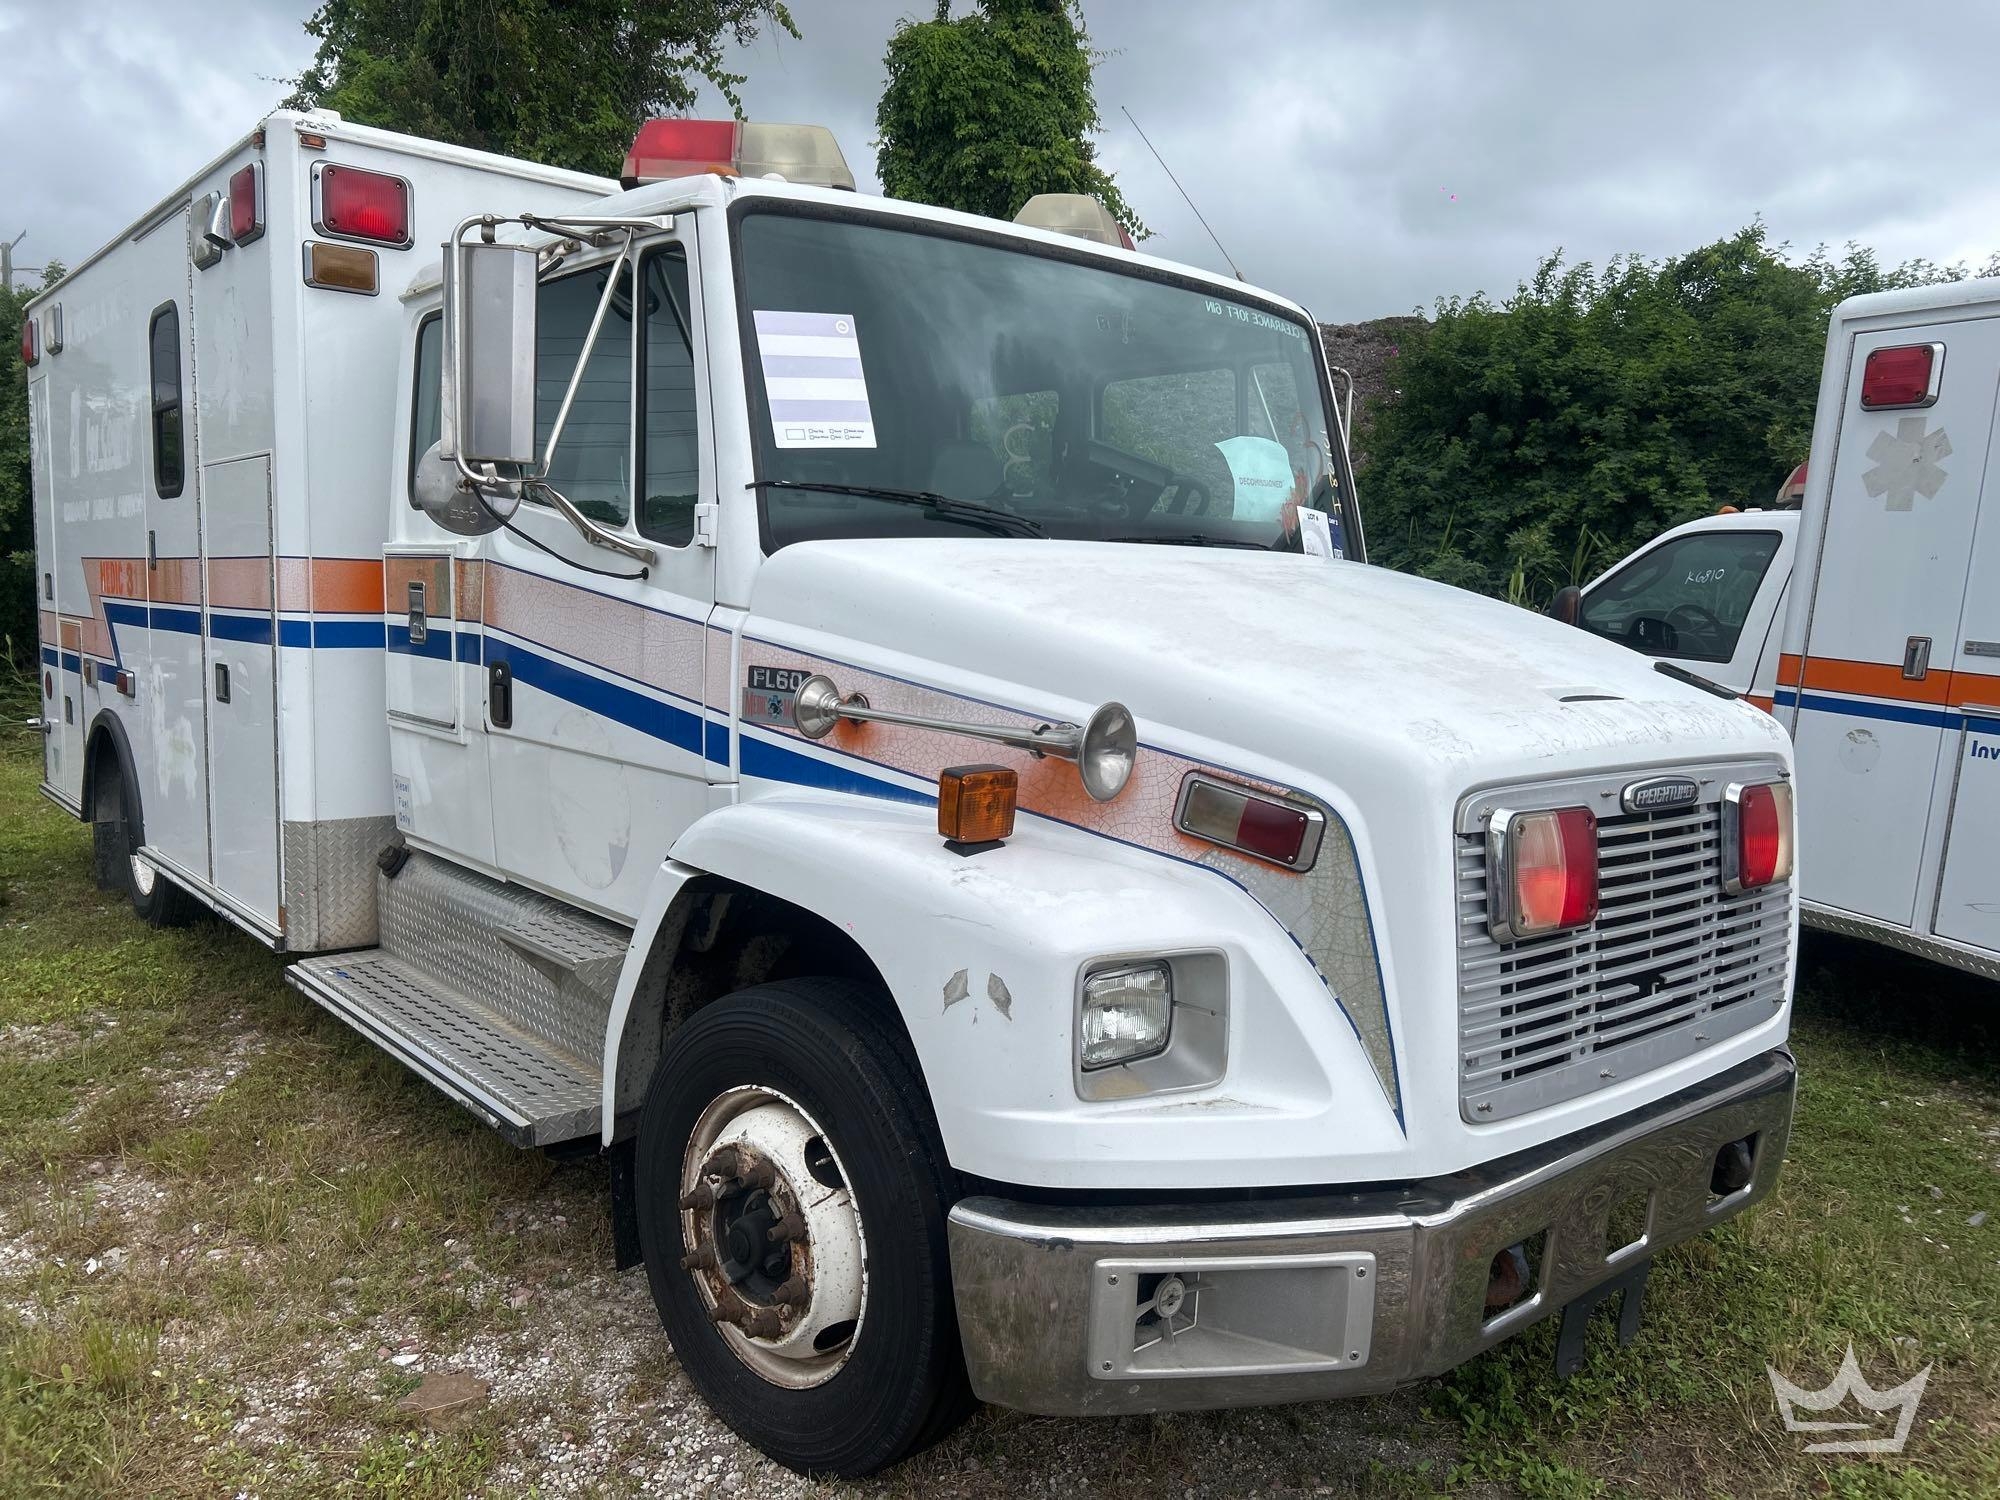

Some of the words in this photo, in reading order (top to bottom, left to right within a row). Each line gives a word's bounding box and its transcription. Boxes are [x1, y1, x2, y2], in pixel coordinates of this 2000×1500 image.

[100, 560, 122, 595] MEDIC
[753, 667, 802, 690] FL60
[1971, 740, 2000, 760] Inv
[1636, 784, 1696, 805] FREIGHTLINER
